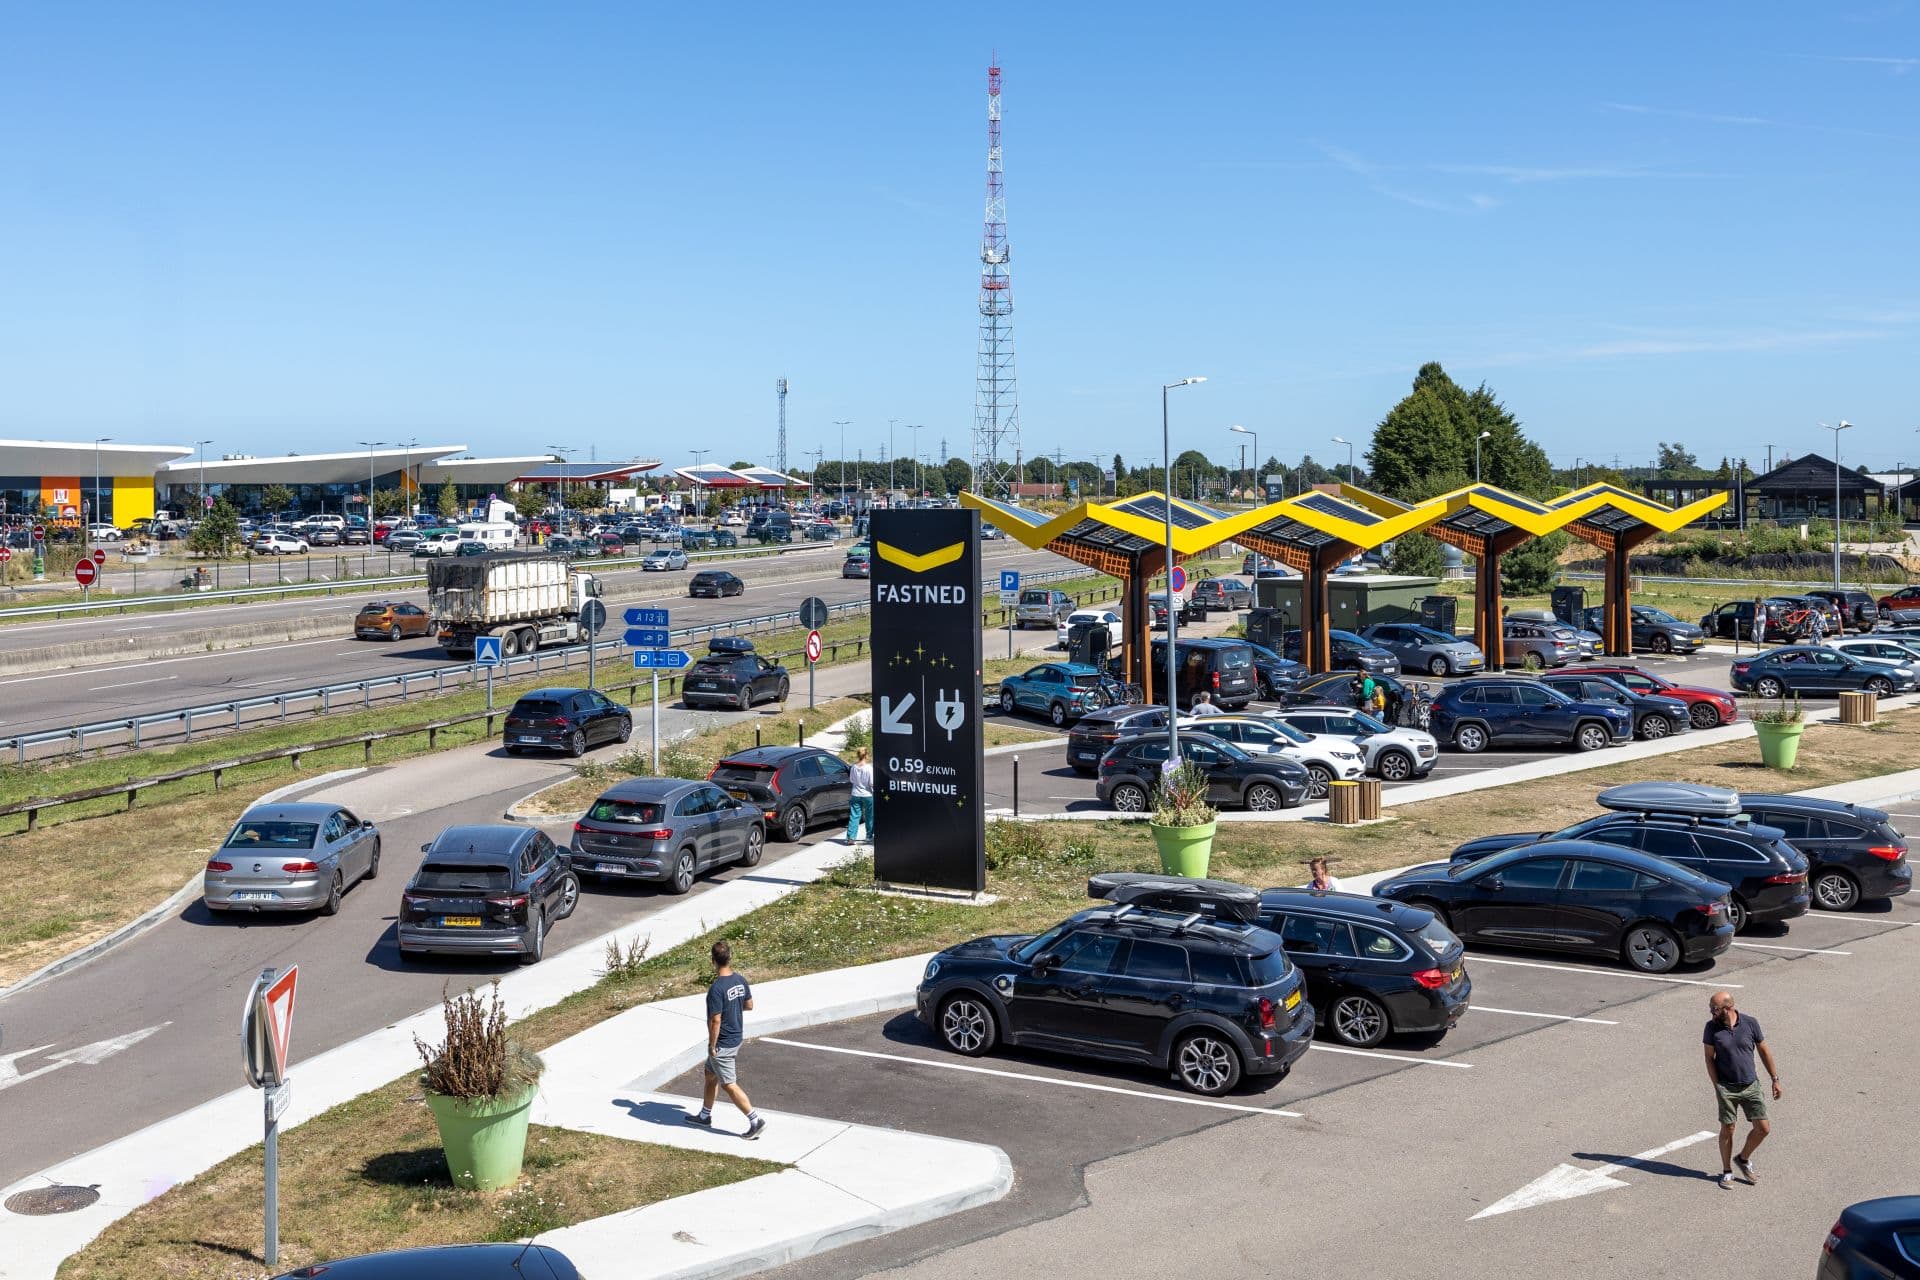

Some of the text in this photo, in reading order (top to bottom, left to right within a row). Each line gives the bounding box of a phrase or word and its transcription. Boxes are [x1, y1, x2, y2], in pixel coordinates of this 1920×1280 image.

[1005, 574, 1014, 588] P
[877, 584, 966, 604] FASTNED
[636, 613, 655, 622] A 13
[657, 634, 664, 645] P
[640, 654, 648, 664] P
[889, 757, 956, 776] 0.59 €/KWh
[889, 780, 957, 795] BIENVENUE
